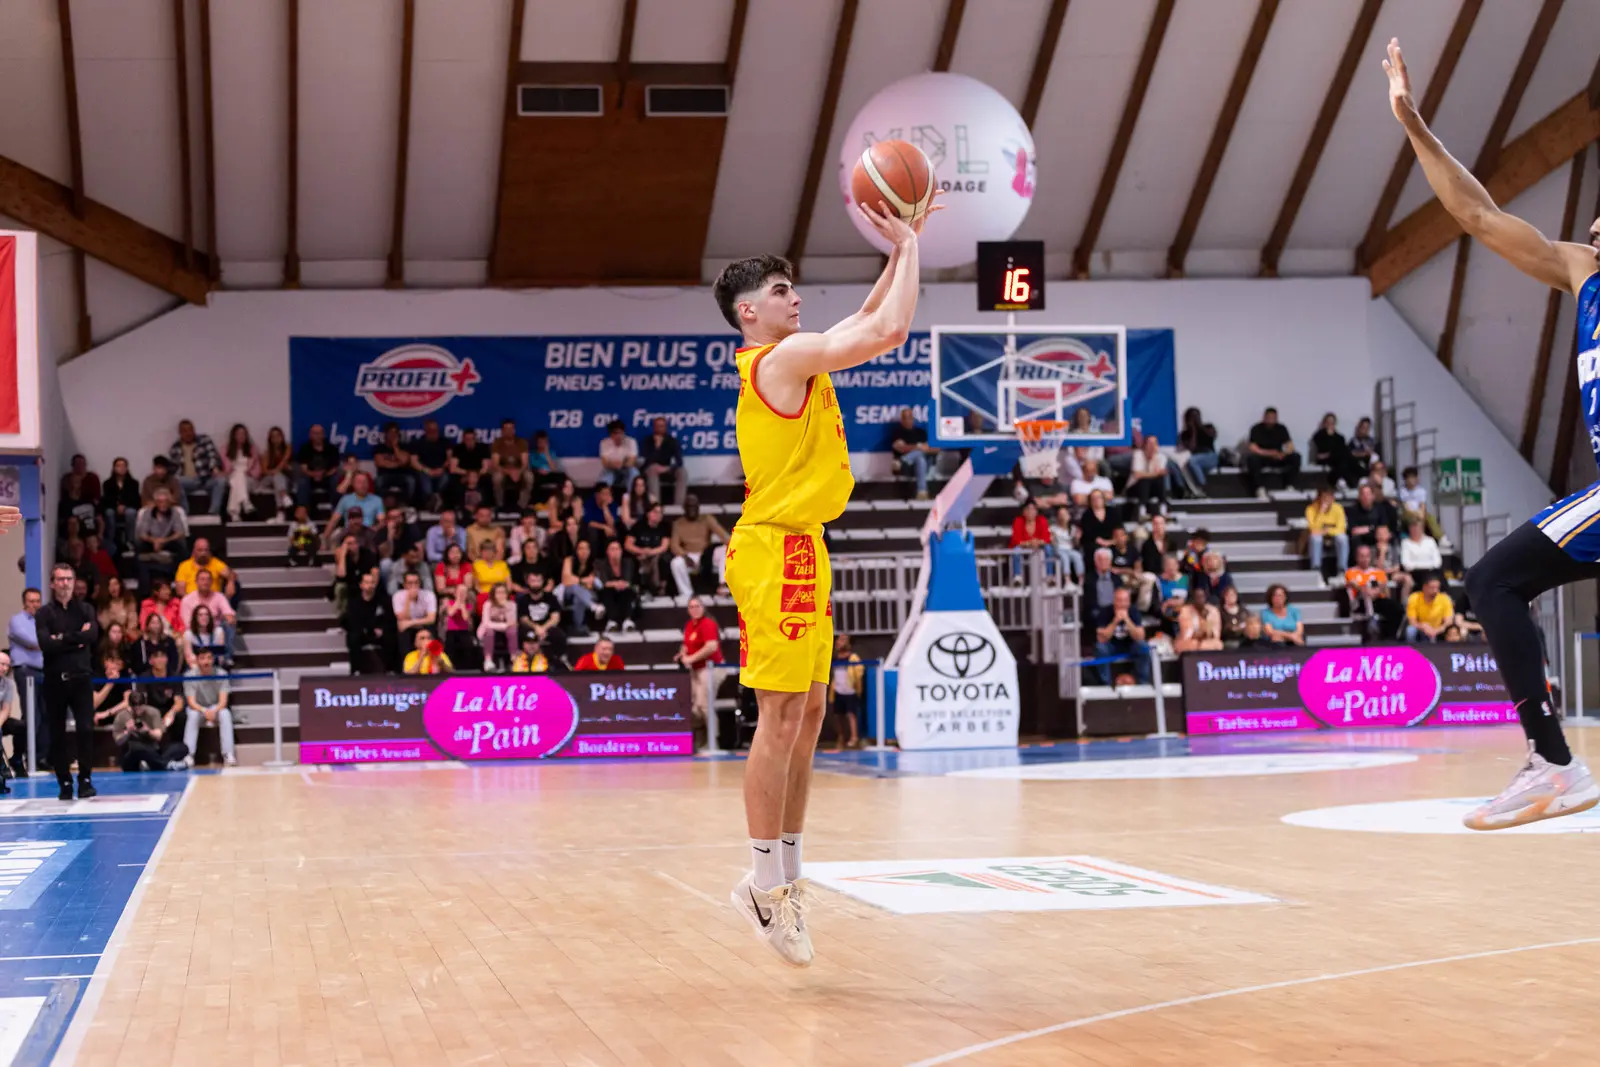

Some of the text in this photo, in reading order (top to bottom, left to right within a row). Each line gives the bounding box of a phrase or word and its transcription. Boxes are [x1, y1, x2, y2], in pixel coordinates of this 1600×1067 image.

[936, 179, 987, 193] DAGE
[1004, 269, 1030, 302] 16
[545, 342, 614, 368] BIEN
[621, 341, 698, 367] PLUS
[545, 374, 604, 391] PNEUS
[620, 373, 697, 390] VIDANGE
[548, 410, 583, 429] 128
[692, 432, 719, 449] 05
[1197, 660, 1301, 683] Boulanger
[1324, 654, 1404, 683] La Mie
[314, 687, 428, 712] Boulanger
[452, 684, 539, 712] La Mie
[590, 682, 677, 701] Pâtissier
[916, 683, 1009, 700] TOYOTA
[1342, 685, 1408, 722] Pain
[469, 716, 541, 755] Pain
[925, 721, 1005, 733] TARBES
